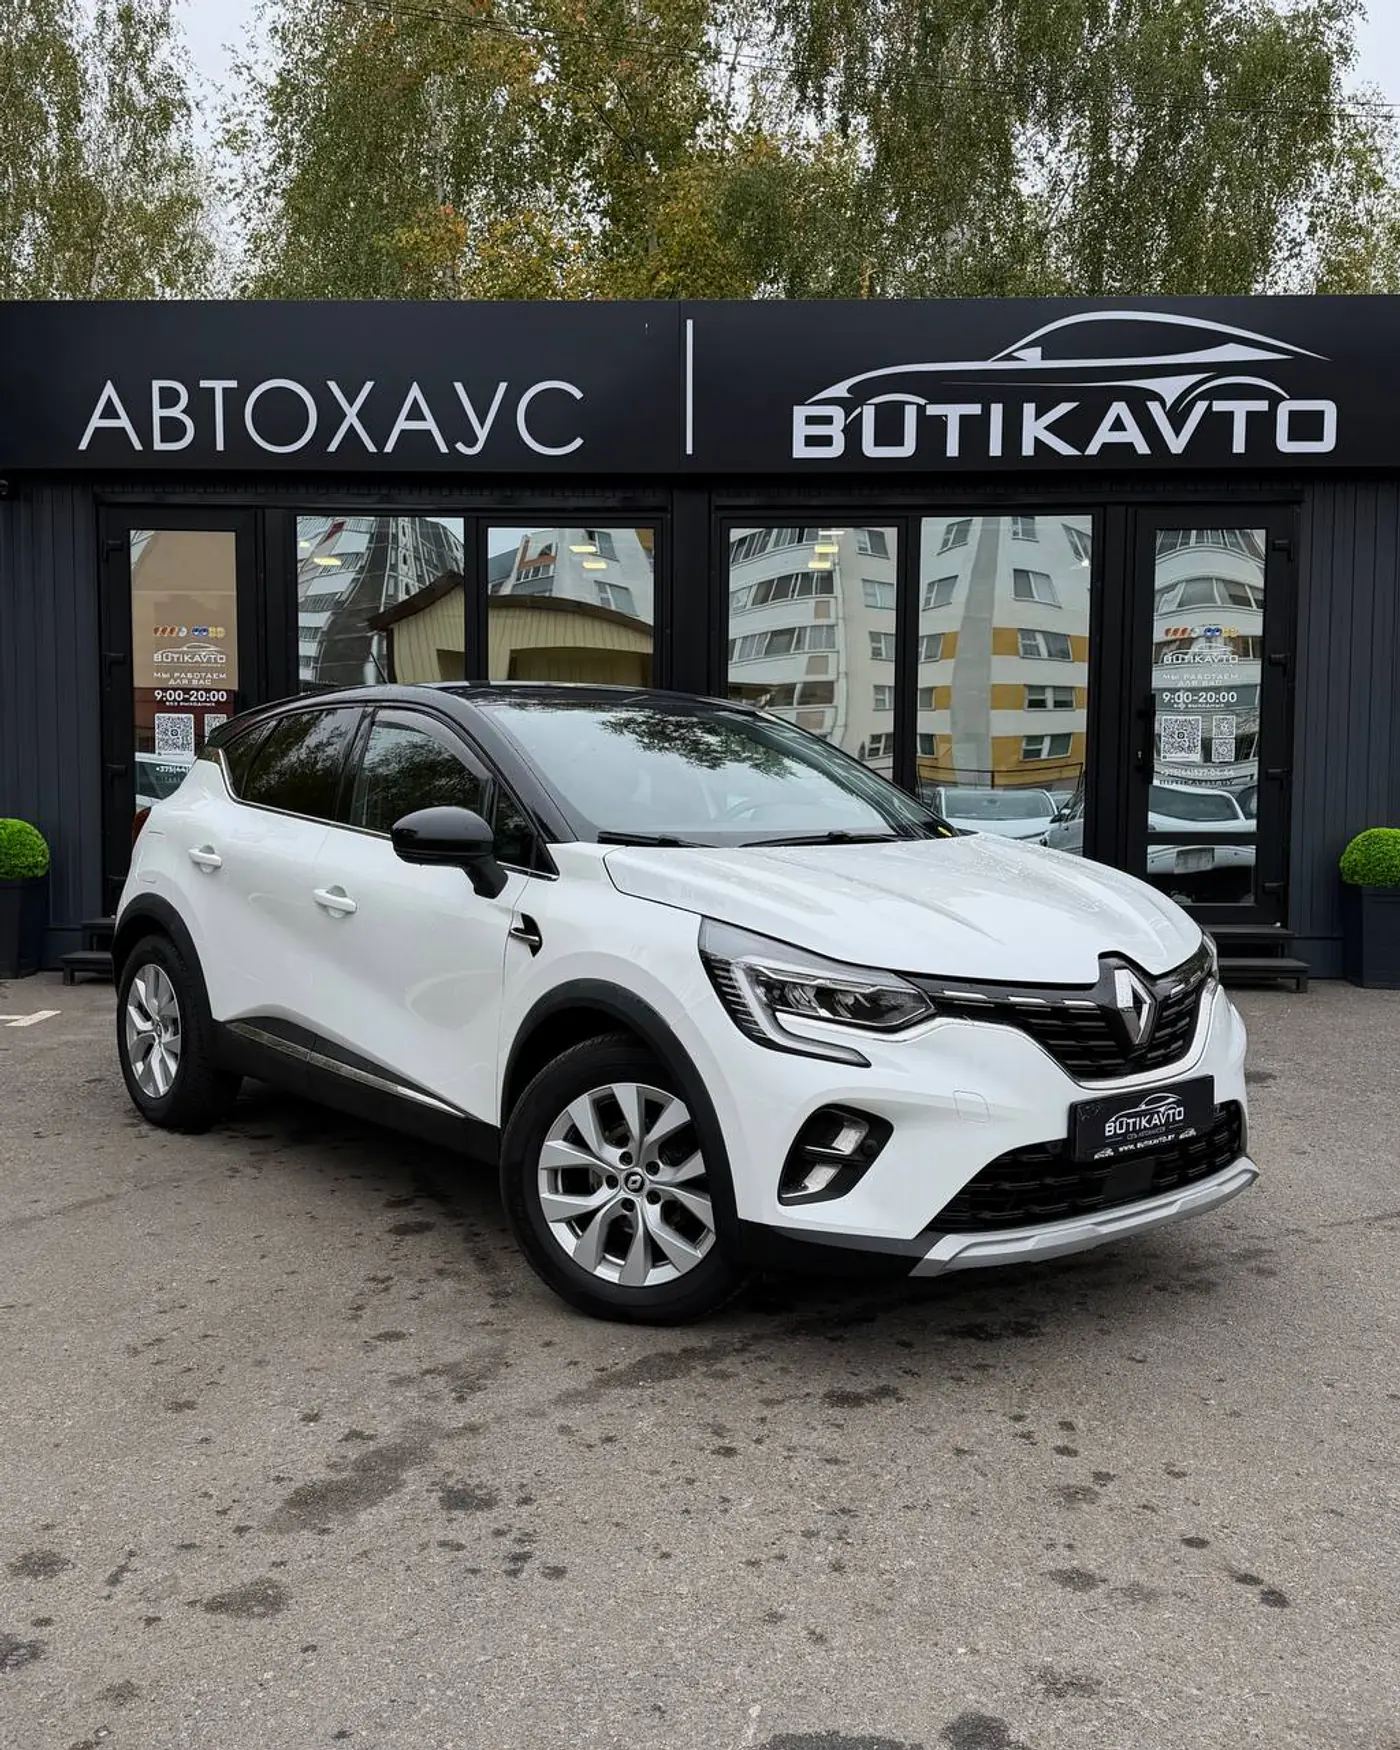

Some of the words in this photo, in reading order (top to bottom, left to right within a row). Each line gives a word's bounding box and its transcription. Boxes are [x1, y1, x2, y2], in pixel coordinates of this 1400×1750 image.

[77, 378, 585, 456] АВТОХАУС
[792, 399, 1338, 459] BUTIKAVTO
[153, 653, 227, 663] BUTIKAVTO
[1163, 654, 1239, 664] BUTIKAVTO
[173, 672, 227, 680] РАБОТАЕМ
[154, 690, 227, 702] 9:00-20:00
[1162, 691, 1237, 703] 9:00-20:00
[1104, 1107, 1184, 1136] BUTIKAVTO
